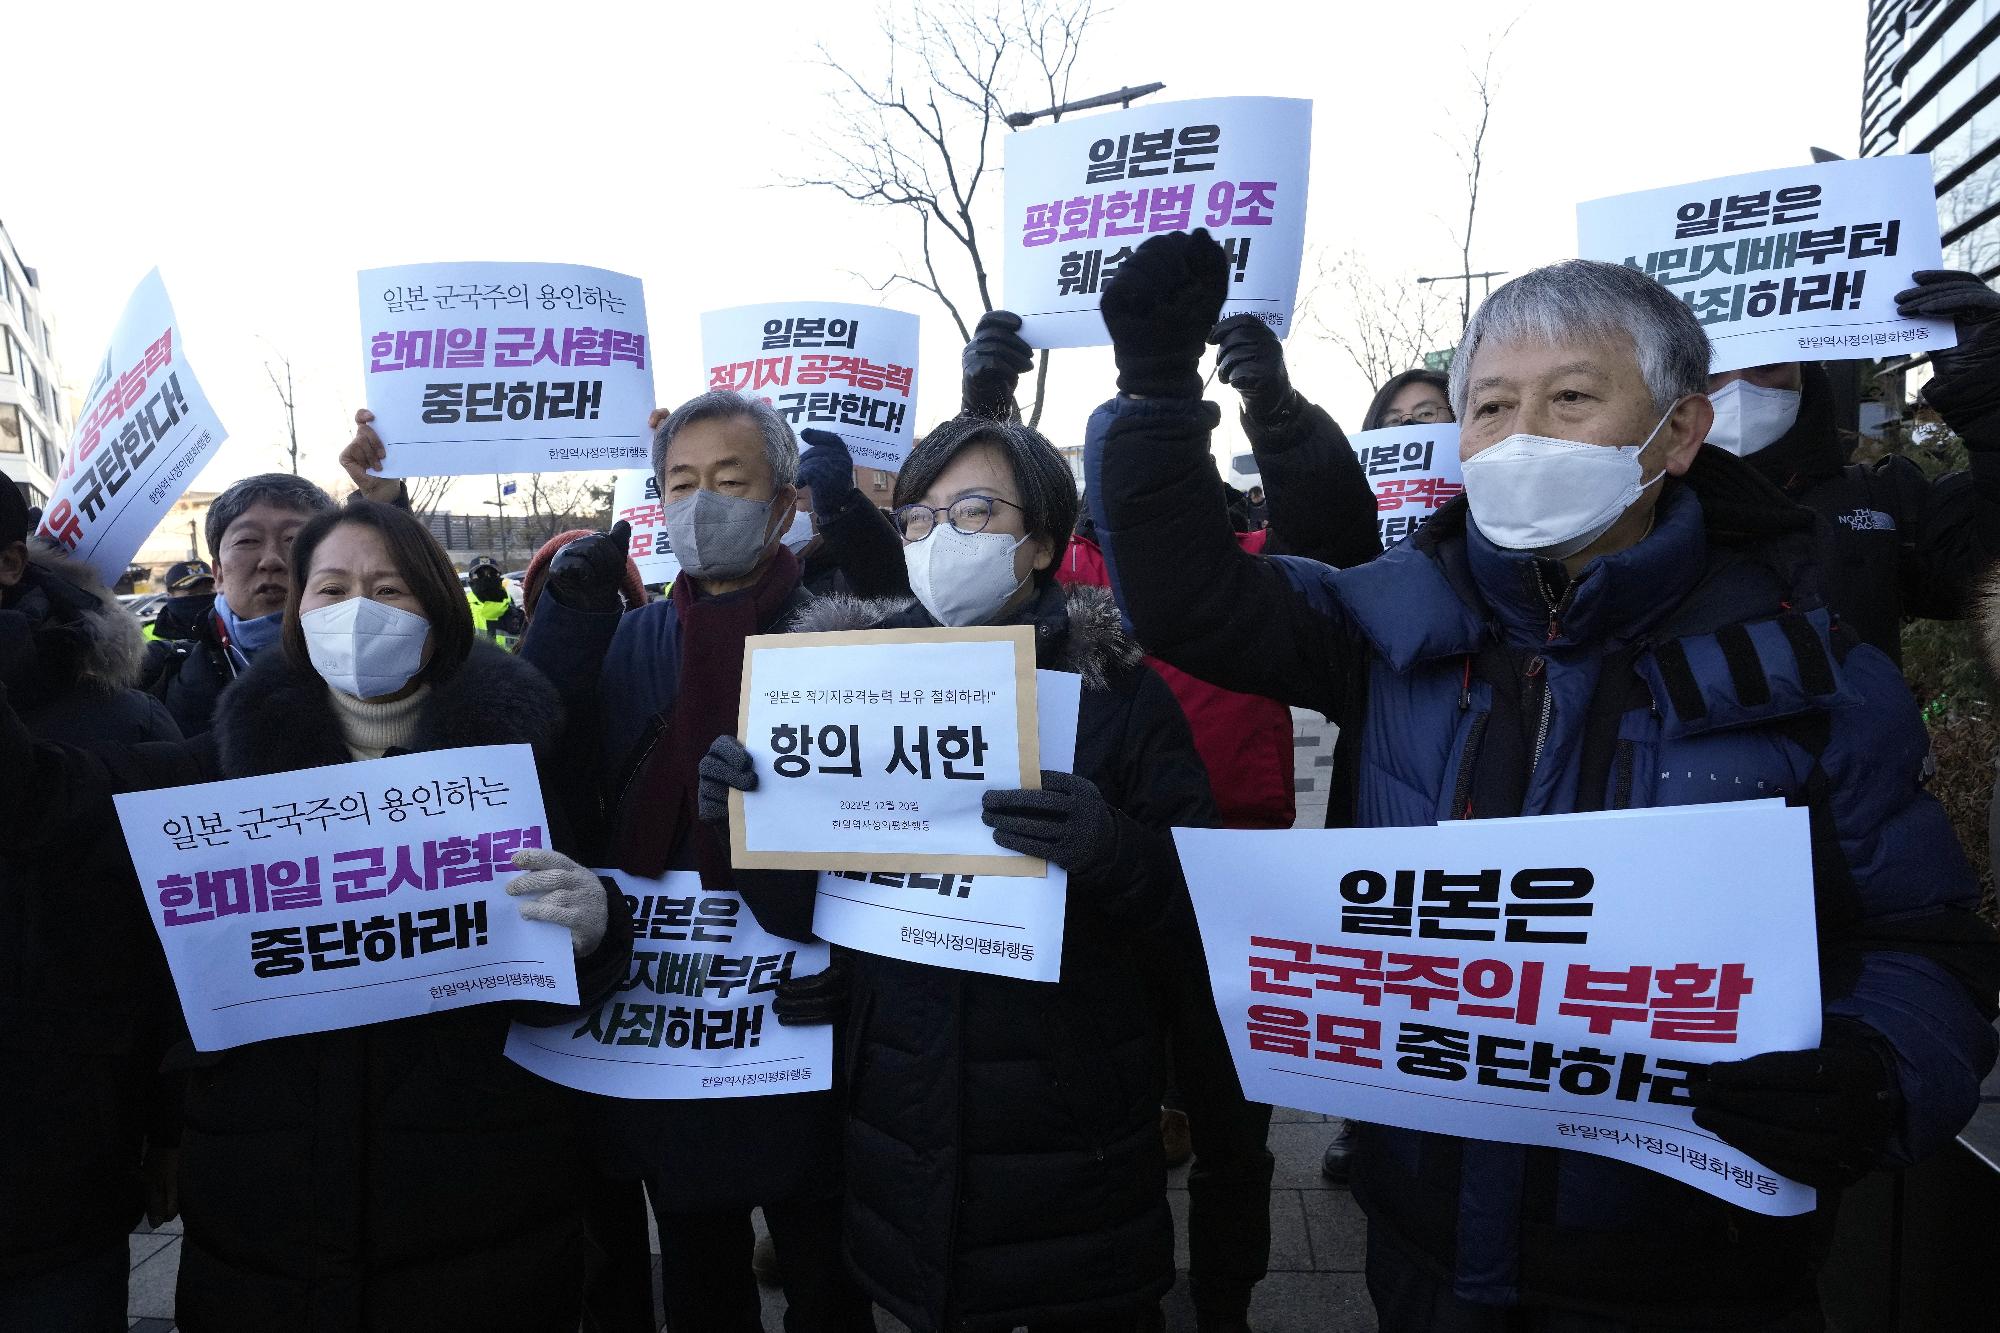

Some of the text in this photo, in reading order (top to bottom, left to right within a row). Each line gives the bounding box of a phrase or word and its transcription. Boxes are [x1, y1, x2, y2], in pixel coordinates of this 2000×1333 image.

[1086, 124, 1221, 184] 일본은
[1022, 180, 1277, 247] 평화헌법 9조
[1674, 184, 1822, 240] 일본은
[383, 283, 626, 314] 일본 군국주의 용인하는
[370, 327, 646, 374] 한미일 군사협력
[761, 317, 859, 350] 일본의
[1798, 327, 1929, 350] 한일역사정의평화행동
[78, 326, 173, 463] 공격능력
[709, 354, 914, 397] 적기지 공격능력
[421, 380, 603, 424] 중단하라!
[778, 392, 907, 434] 규탄한다!
[71, 370, 190, 524] 규탄한다!
[148, 428, 213, 506] 한일역사정의평화행동
[548, 447, 648, 460] 한일역사정의평화행동
[805, 688, 894, 706] 적기지공격능력
[898, 688, 925, 706] 보유
[770, 723, 989, 781] 항의 서한
[163, 776, 511, 851] 일본 군국주의 용인하는
[832, 819, 931, 831] 한일역사정의평화행동
[840, 800, 919, 812] 2022년 12월 20일
[156, 825, 543, 927] 한미일 군사협력
[623, 894, 740, 943] 일본은
[1339, 867, 1595, 945] 일본은
[250, 900, 489, 979] 중단하라!
[900, 926, 1035, 962] 한일역사정의평화행동
[429, 971, 557, 999] 한일역사정의평화행동
[1248, 935, 1754, 1044] 군국주의 부활
[571, 1002, 765, 1050] 사죄하라!
[1246, 1004, 1383, 1070] 음모
[701, 1067, 813, 1088] 한일역사정의평화행동
[1556, 1122, 1780, 1197] 한일역사정의평화행동
